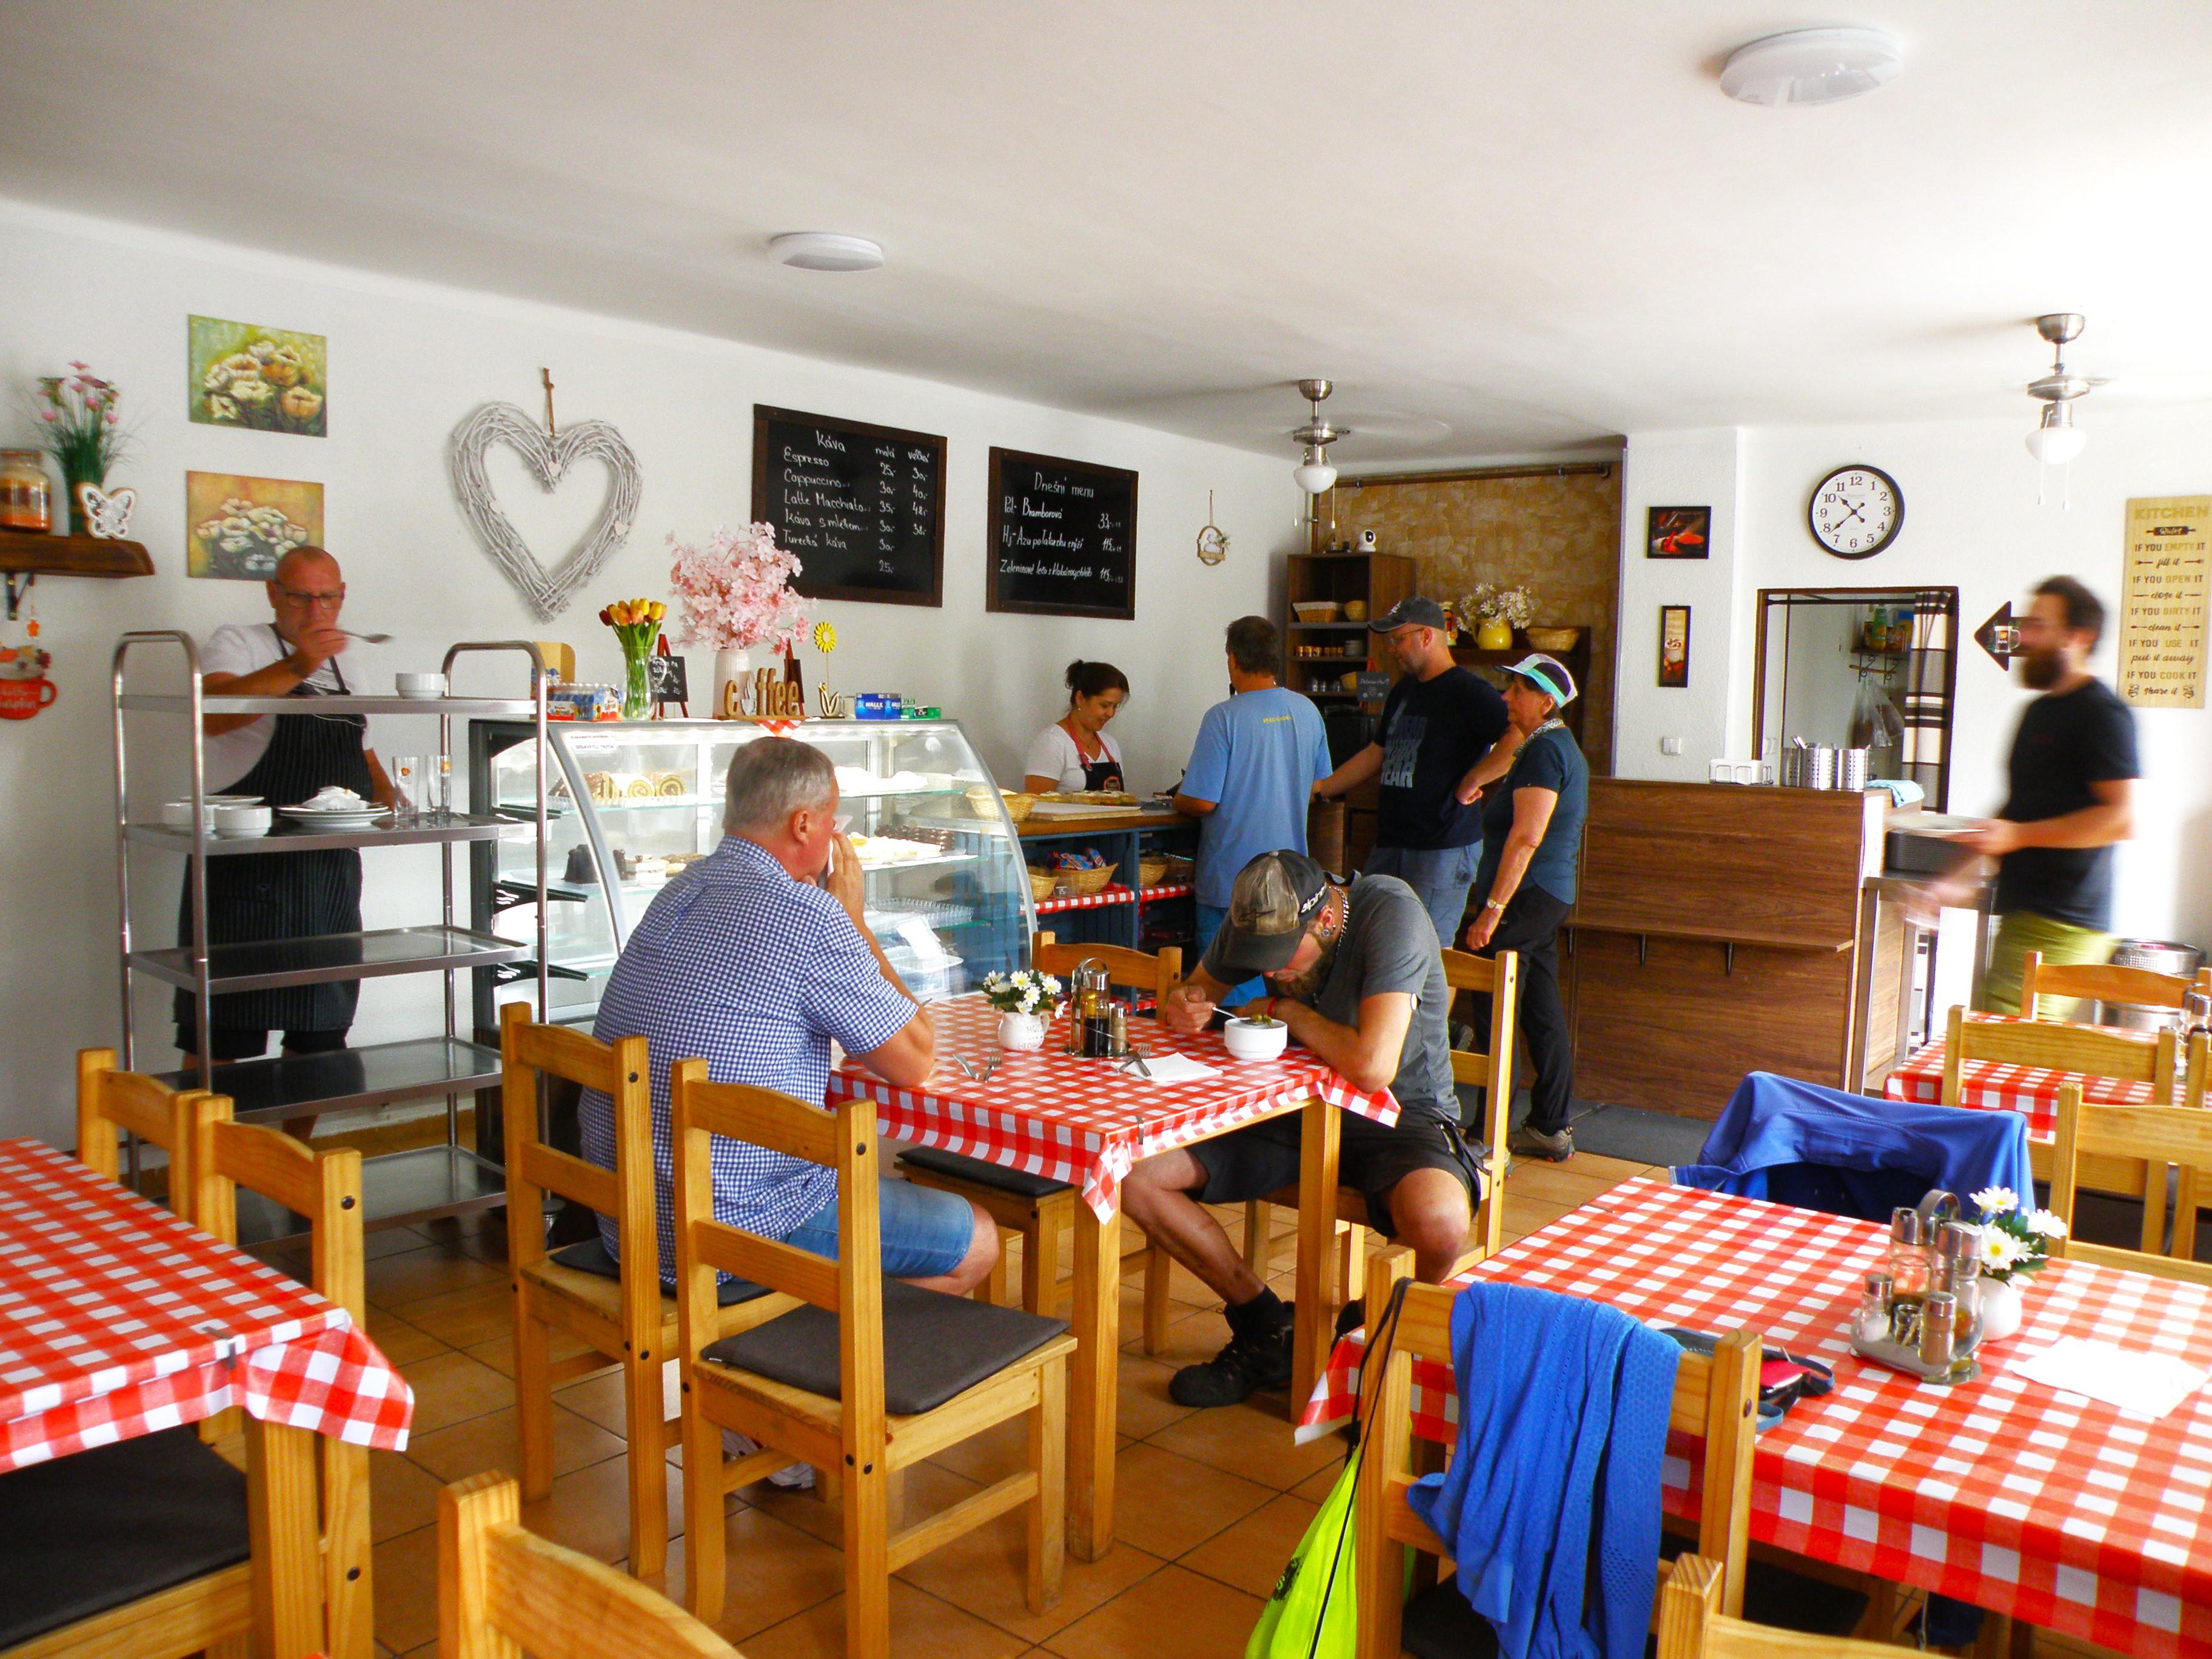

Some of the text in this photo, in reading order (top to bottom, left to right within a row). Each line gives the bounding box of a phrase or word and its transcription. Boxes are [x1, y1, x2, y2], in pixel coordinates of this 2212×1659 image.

[816, 430, 846, 452] Káva
[783, 446, 829, 467] Espresso
[1034, 472, 1094, 498] Dnešní menu
[1850, 476, 1863, 486] 12
[1871, 481, 1876, 491] 1
[1836, 483, 1845, 492] 11
[785, 489, 811, 505] Latte
[816, 492, 864, 512] Macchiato
[1824, 493, 1836, 503] 10
[1880, 492, 1888, 501] 2
[1820, 508, 1828, 518] 9
[1883, 506, 1891, 516] 3
[2134, 506, 2208, 520] KITCHEN
[785, 509, 811, 526] Káva
[1823, 523, 1831, 532] 8
[1877, 521, 1885, 531] 4
[1833, 534, 1840, 544] 7
[1850, 538, 1857, 548] 6
[1866, 534, 1874, 543] 5
[2164, 543, 2194, 551] EMPTY
[2156, 558, 2170, 569] fill
[2131, 654, 2151, 665] put
[2162, 655, 2194, 665] away
